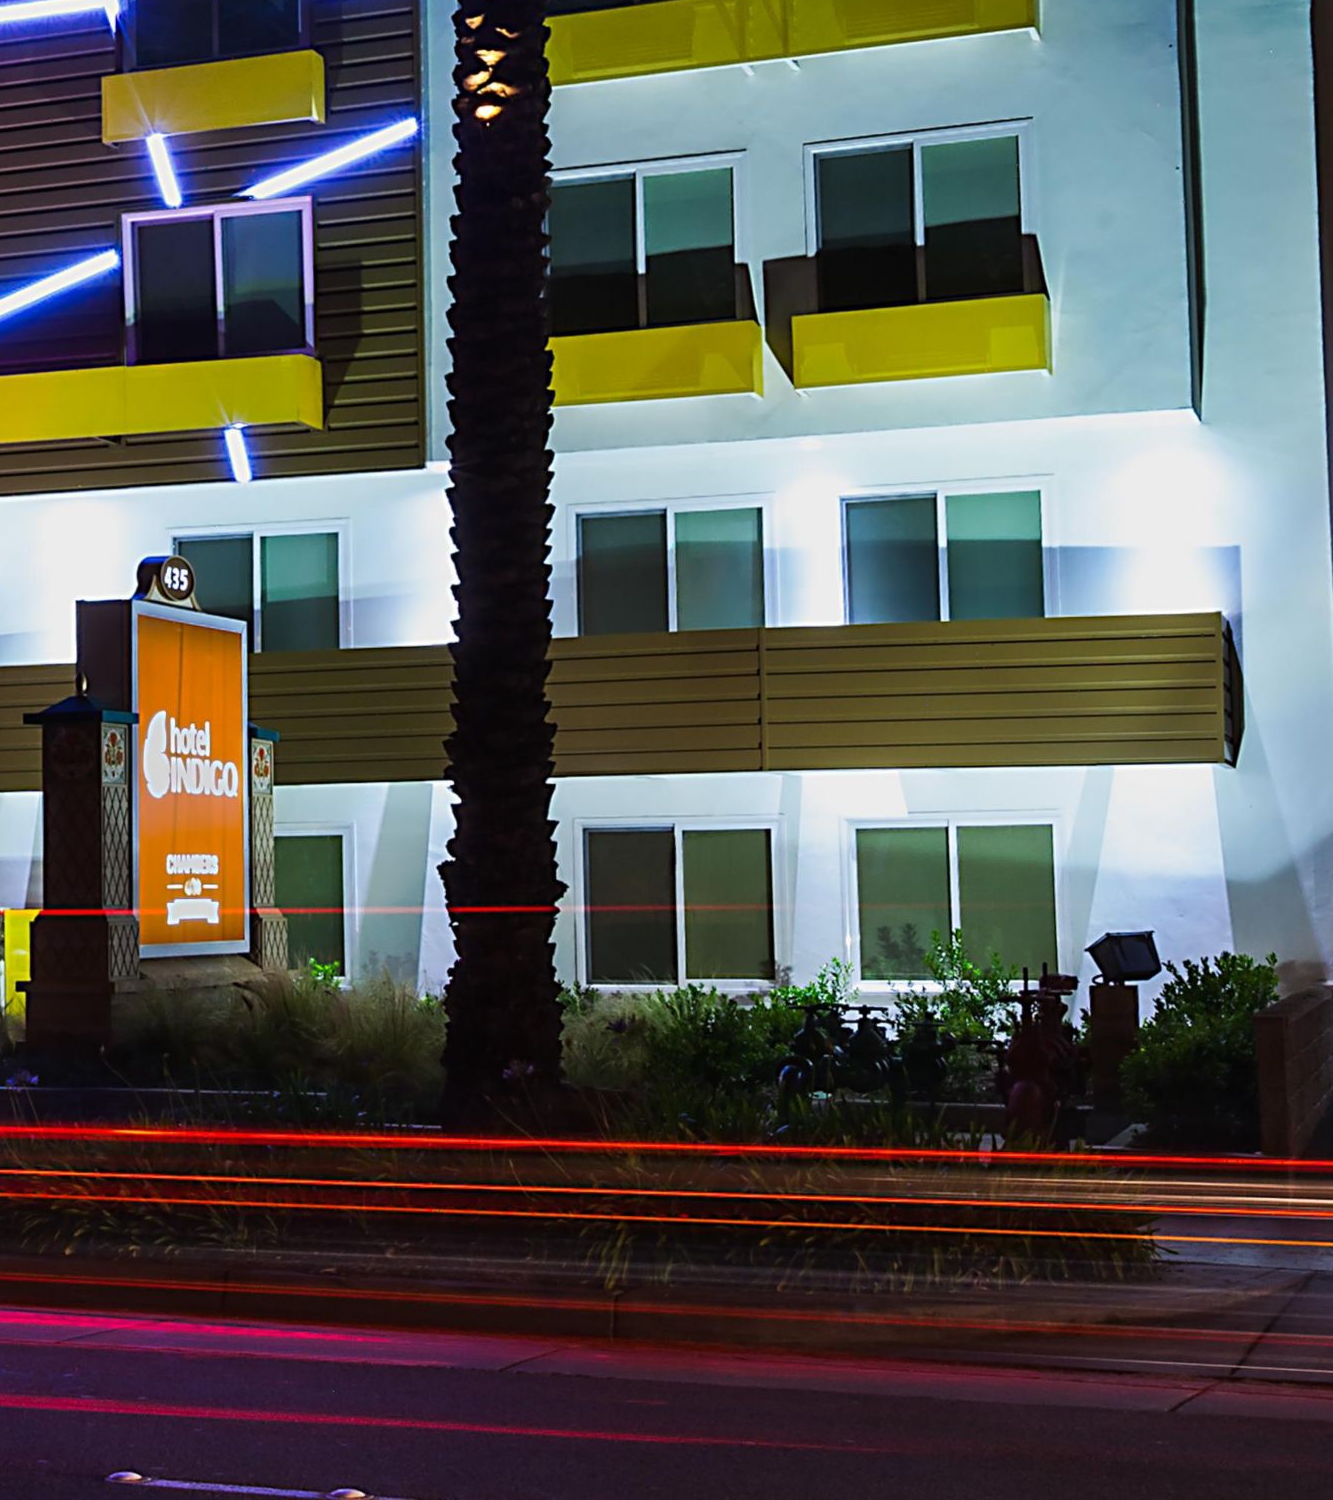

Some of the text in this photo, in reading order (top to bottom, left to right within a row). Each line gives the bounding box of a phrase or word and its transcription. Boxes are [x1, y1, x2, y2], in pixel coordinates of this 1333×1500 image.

[164, 566, 189, 592] 435
[170, 717, 211, 757] hotel
[170, 756, 239, 798] INDIGO
